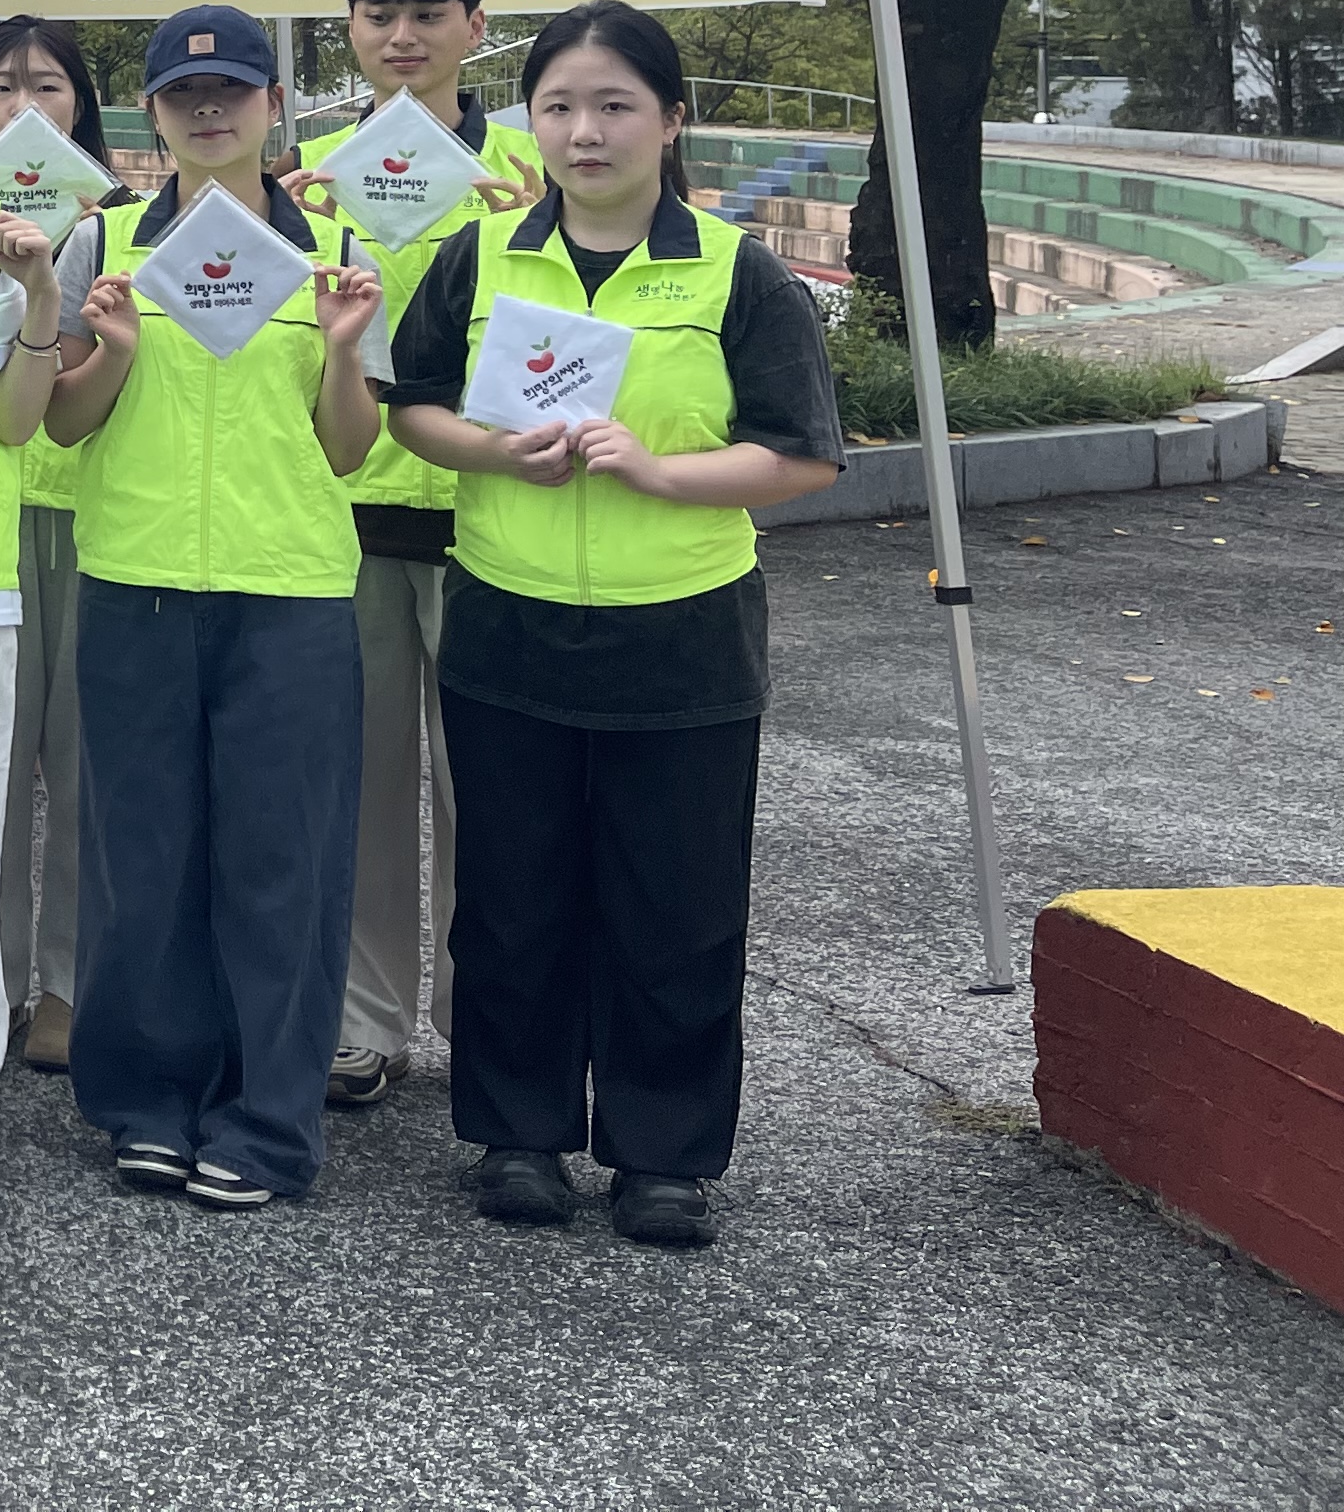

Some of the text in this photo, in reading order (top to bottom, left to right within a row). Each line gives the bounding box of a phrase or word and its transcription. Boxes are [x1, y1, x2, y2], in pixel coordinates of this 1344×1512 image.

[363, 175, 429, 190] 희망의씨앗
[184, 281, 254, 296] 희망의씨앗
[522, 357, 586, 402] 희망의씨앗
